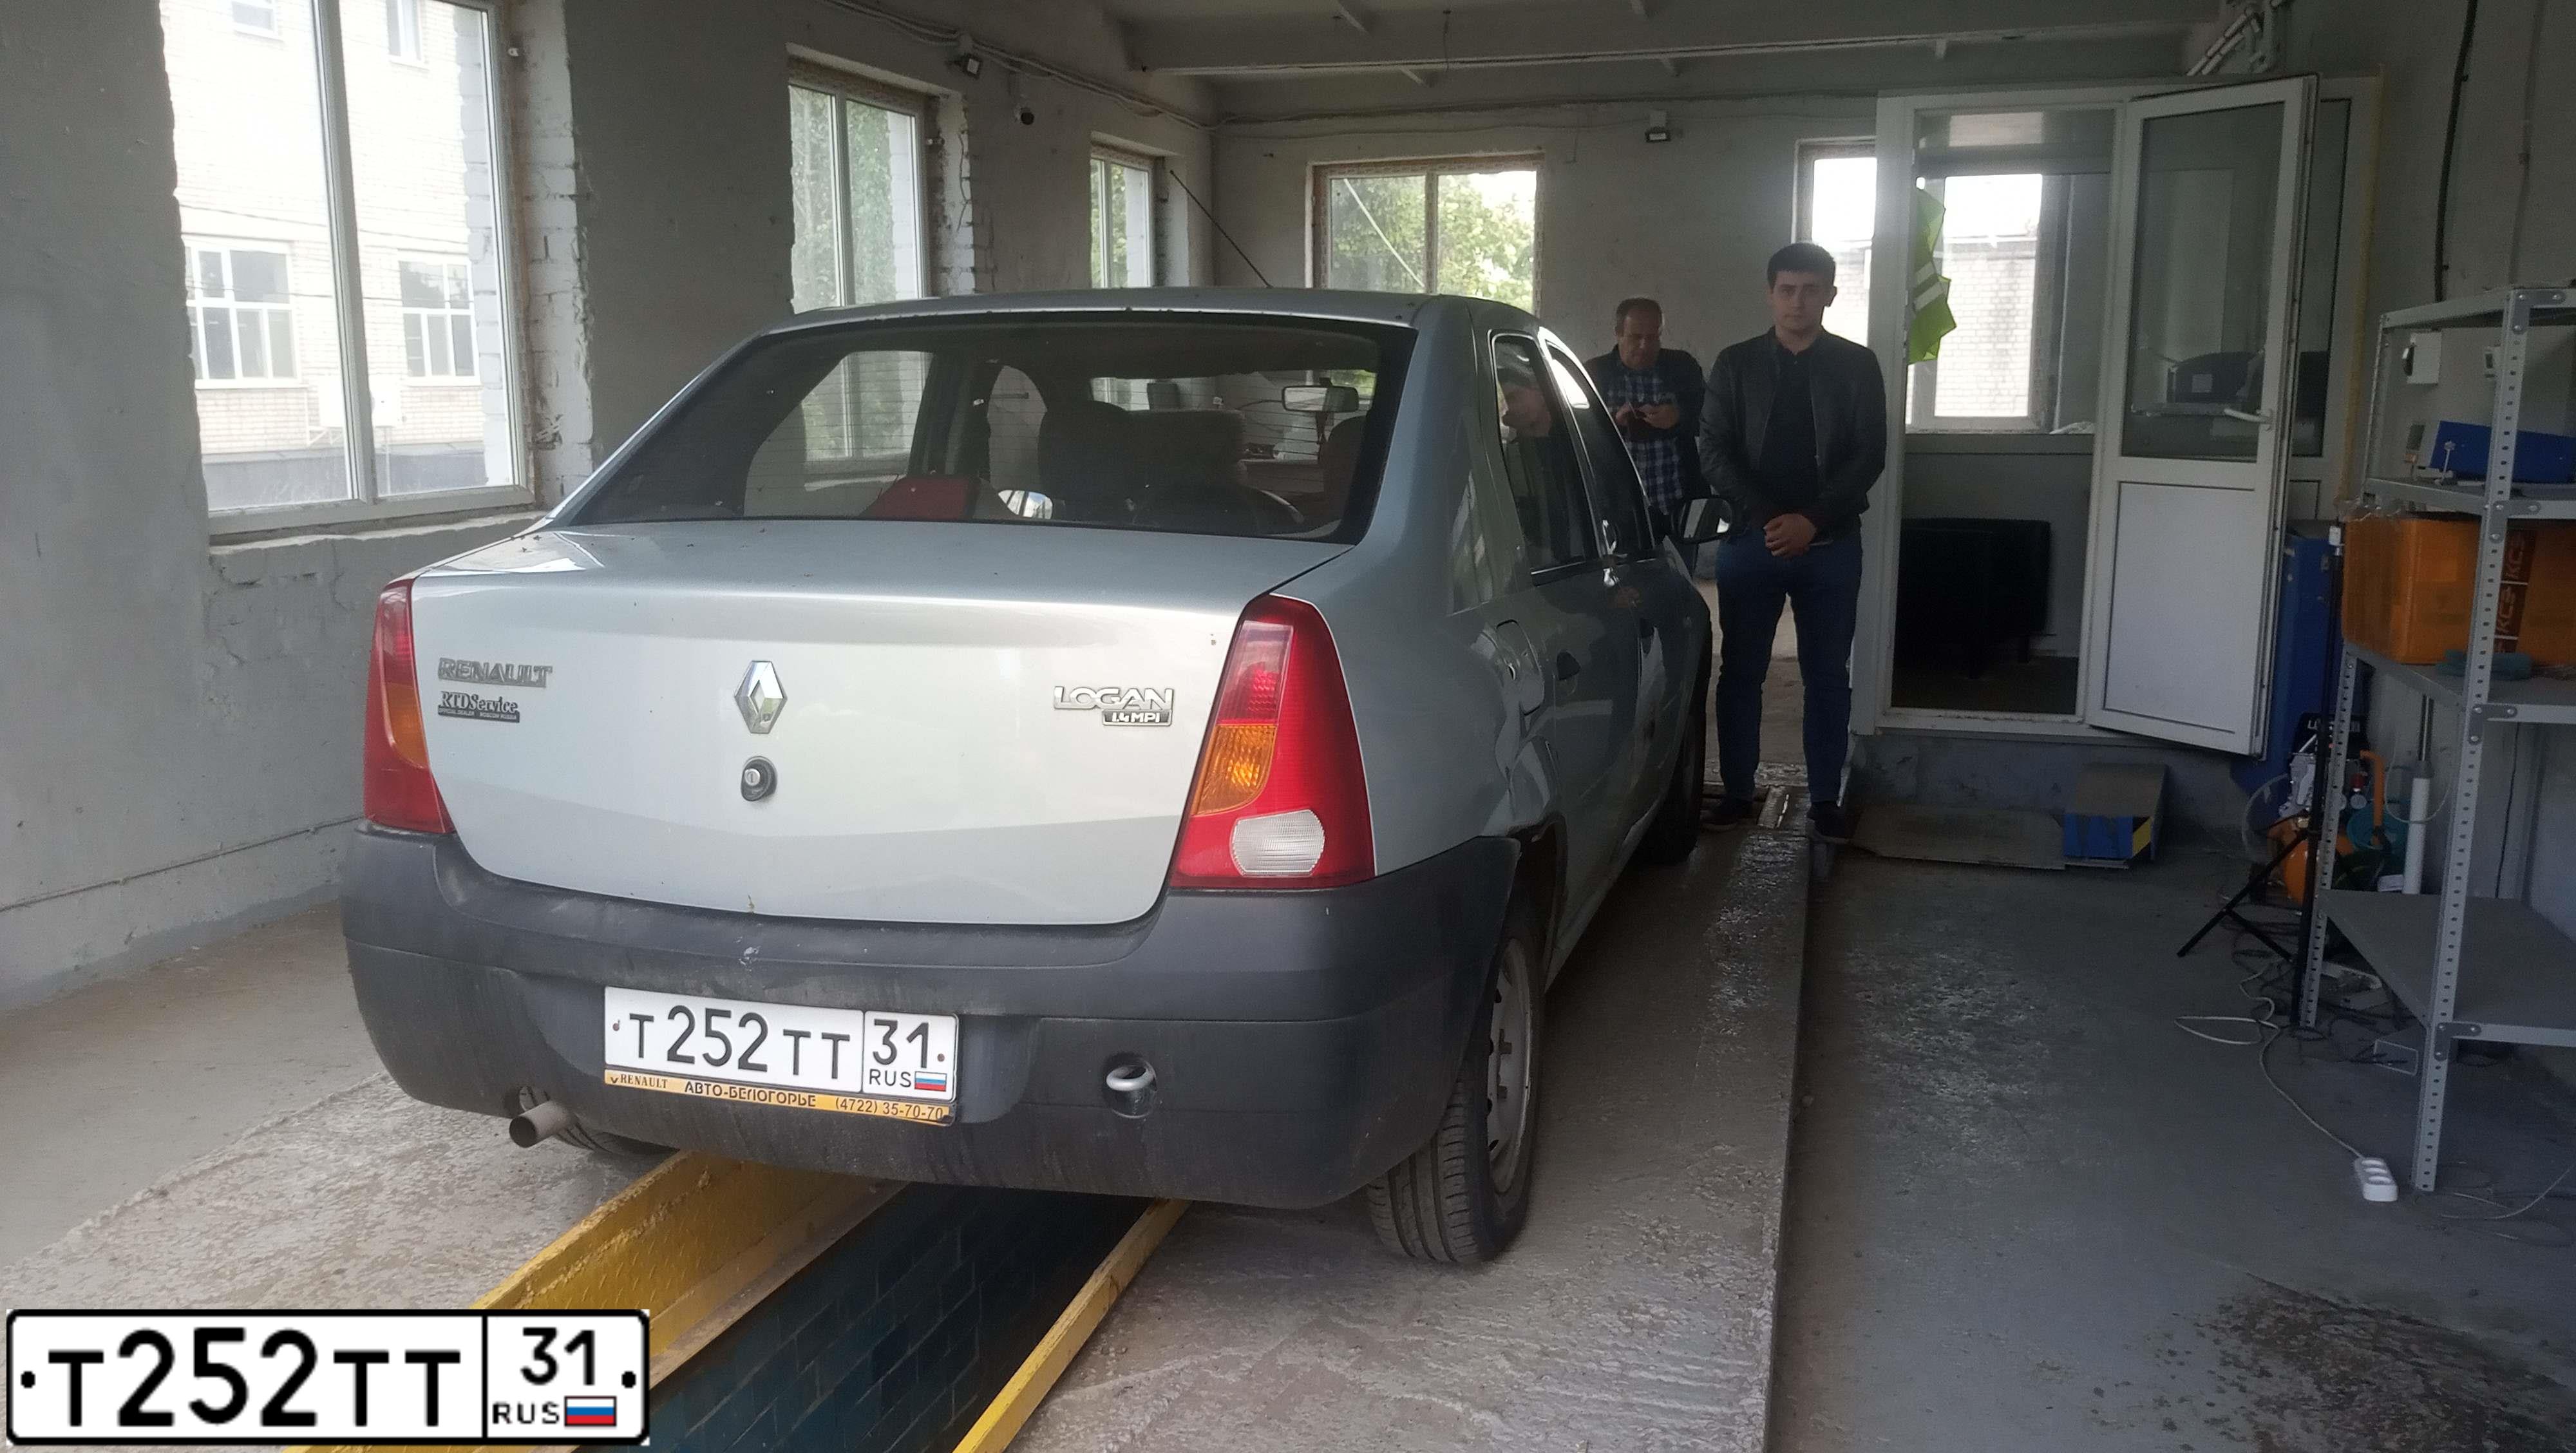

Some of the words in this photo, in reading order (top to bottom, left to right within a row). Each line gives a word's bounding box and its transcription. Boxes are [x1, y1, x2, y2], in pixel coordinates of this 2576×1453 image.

[438, 658, 553, 688] RENAULT
[1054, 686, 1175, 710] LOGAN
[873, 1020, 929, 1068] 31
[621, 1074, 668, 1089] RENAULT
[869, 1068, 911, 1088] RUS
[685, 1081, 816, 1107] АВТО-БЕЛОГОРЬЕ
[835, 1097, 878, 1114] (4722)
[883, 1102, 943, 1120] 35-70-70
